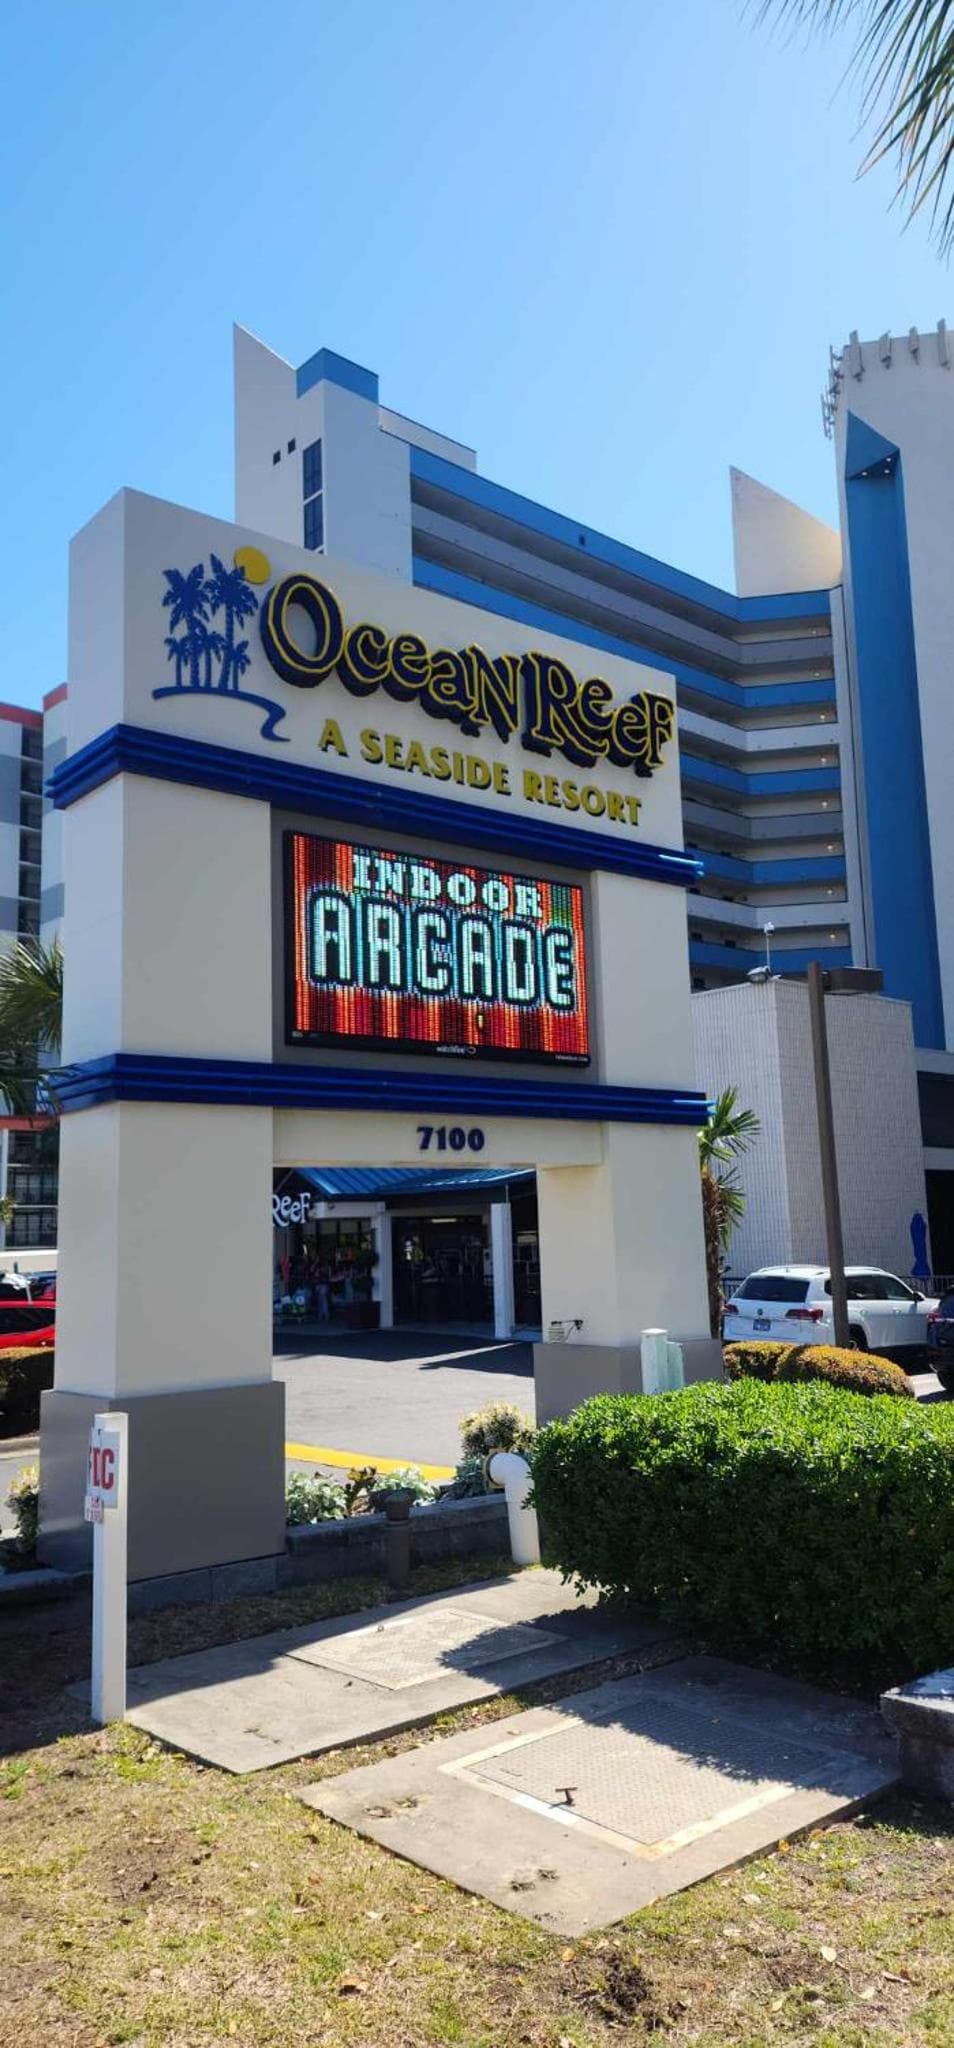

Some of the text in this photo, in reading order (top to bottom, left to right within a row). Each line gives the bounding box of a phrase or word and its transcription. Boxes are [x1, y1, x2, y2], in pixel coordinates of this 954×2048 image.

[318, 718, 643, 826] A SEASIDE RESORT
[352, 854, 543, 918] INDOOR
[311, 893, 574, 1008] ARCADE
[416, 1125, 485, 1151] 7100
